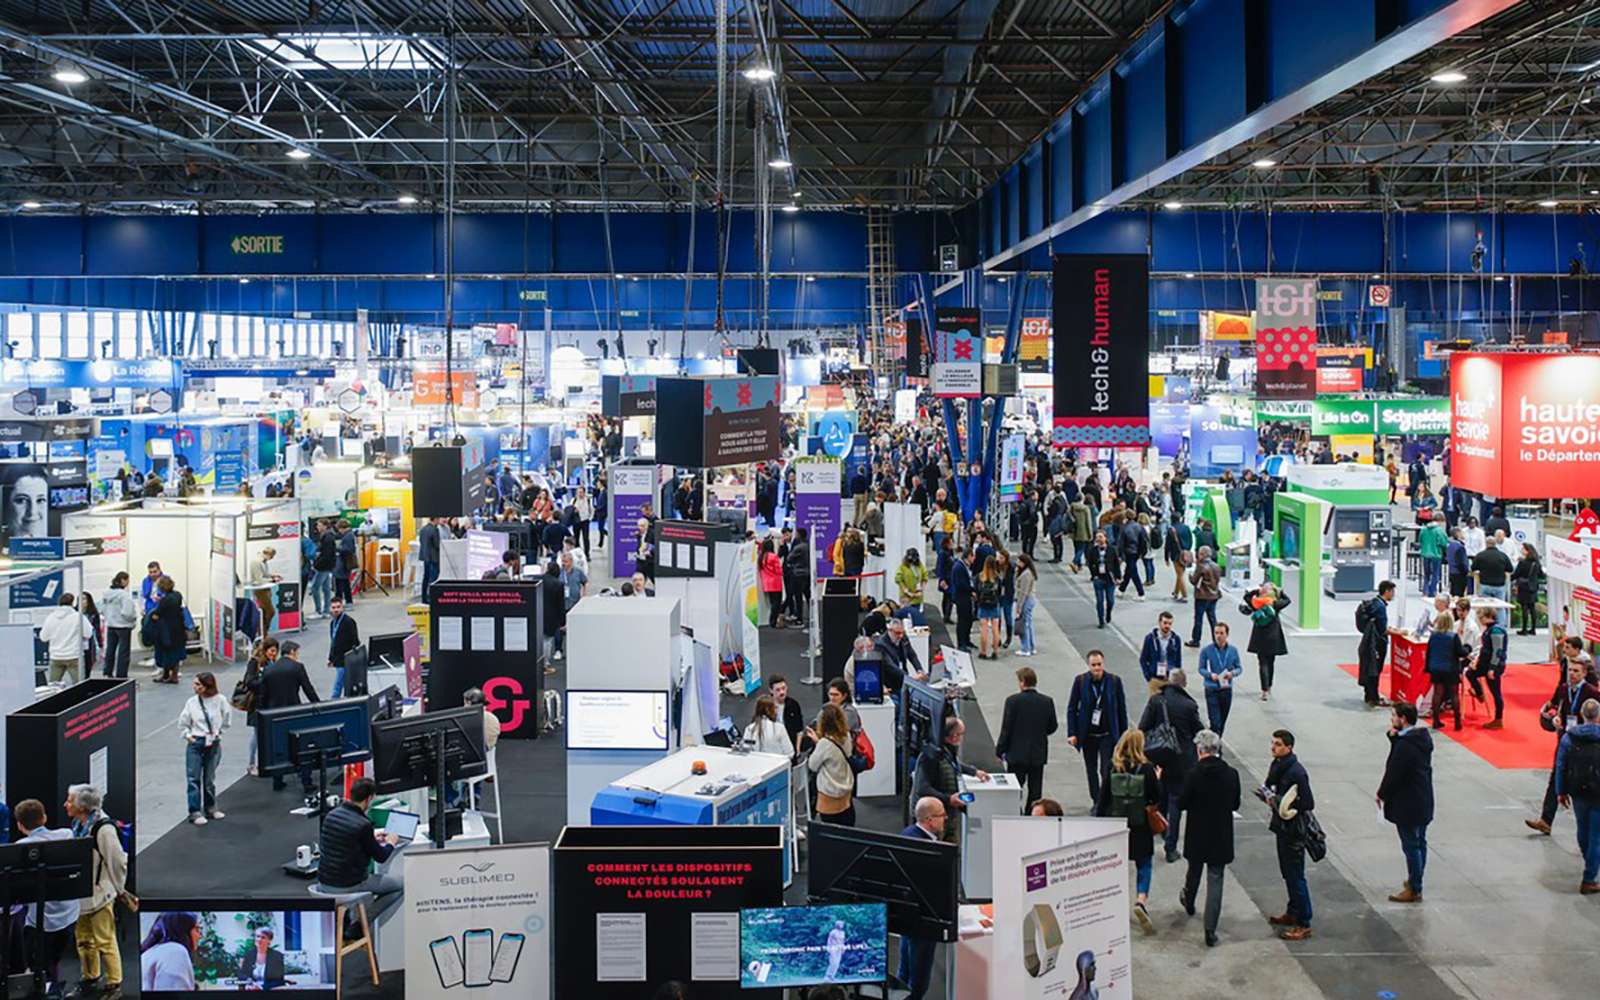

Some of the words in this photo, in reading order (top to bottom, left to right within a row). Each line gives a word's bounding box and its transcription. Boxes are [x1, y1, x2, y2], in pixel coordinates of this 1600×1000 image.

[240, 235, 283, 253] SORTIE
[525, 291, 547, 301] SORTIE
[1260, 283, 1313, 317] t&f
[1091, 268, 1110, 412] tech&human
[1520, 395, 1600, 423] haute
[1320, 411, 1339, 424] Life
[1351, 410, 1369, 424] On
[1382, 409, 1452, 423] Schneider
[0, 427, 21, 436] ctual
[720, 431, 746, 440] COMMENT
[1520, 424, 1600, 445] savoi
[720, 439, 736, 447] NOUS
[1520, 449, 1533, 461] le
[1075, 850, 1098, 860] charge
[587, 863, 649, 873] COMMENT
[651, 863, 674, 873] LES
[676, 863, 752, 873] DISPOSITIFS
[439, 873, 516, 887] SUBLIMED
[594, 875, 669, 886] CONNECTÉS
[671, 876, 745, 886] SOULAGENT
[1067, 869, 1091, 881] douleur
[463, 894, 494, 903] thérapie
[495, 892, 534, 900] connectée
[627, 889, 643, 899] LA
[645, 889, 703, 899] DOULEUR
[705, 889, 712, 899] ?
